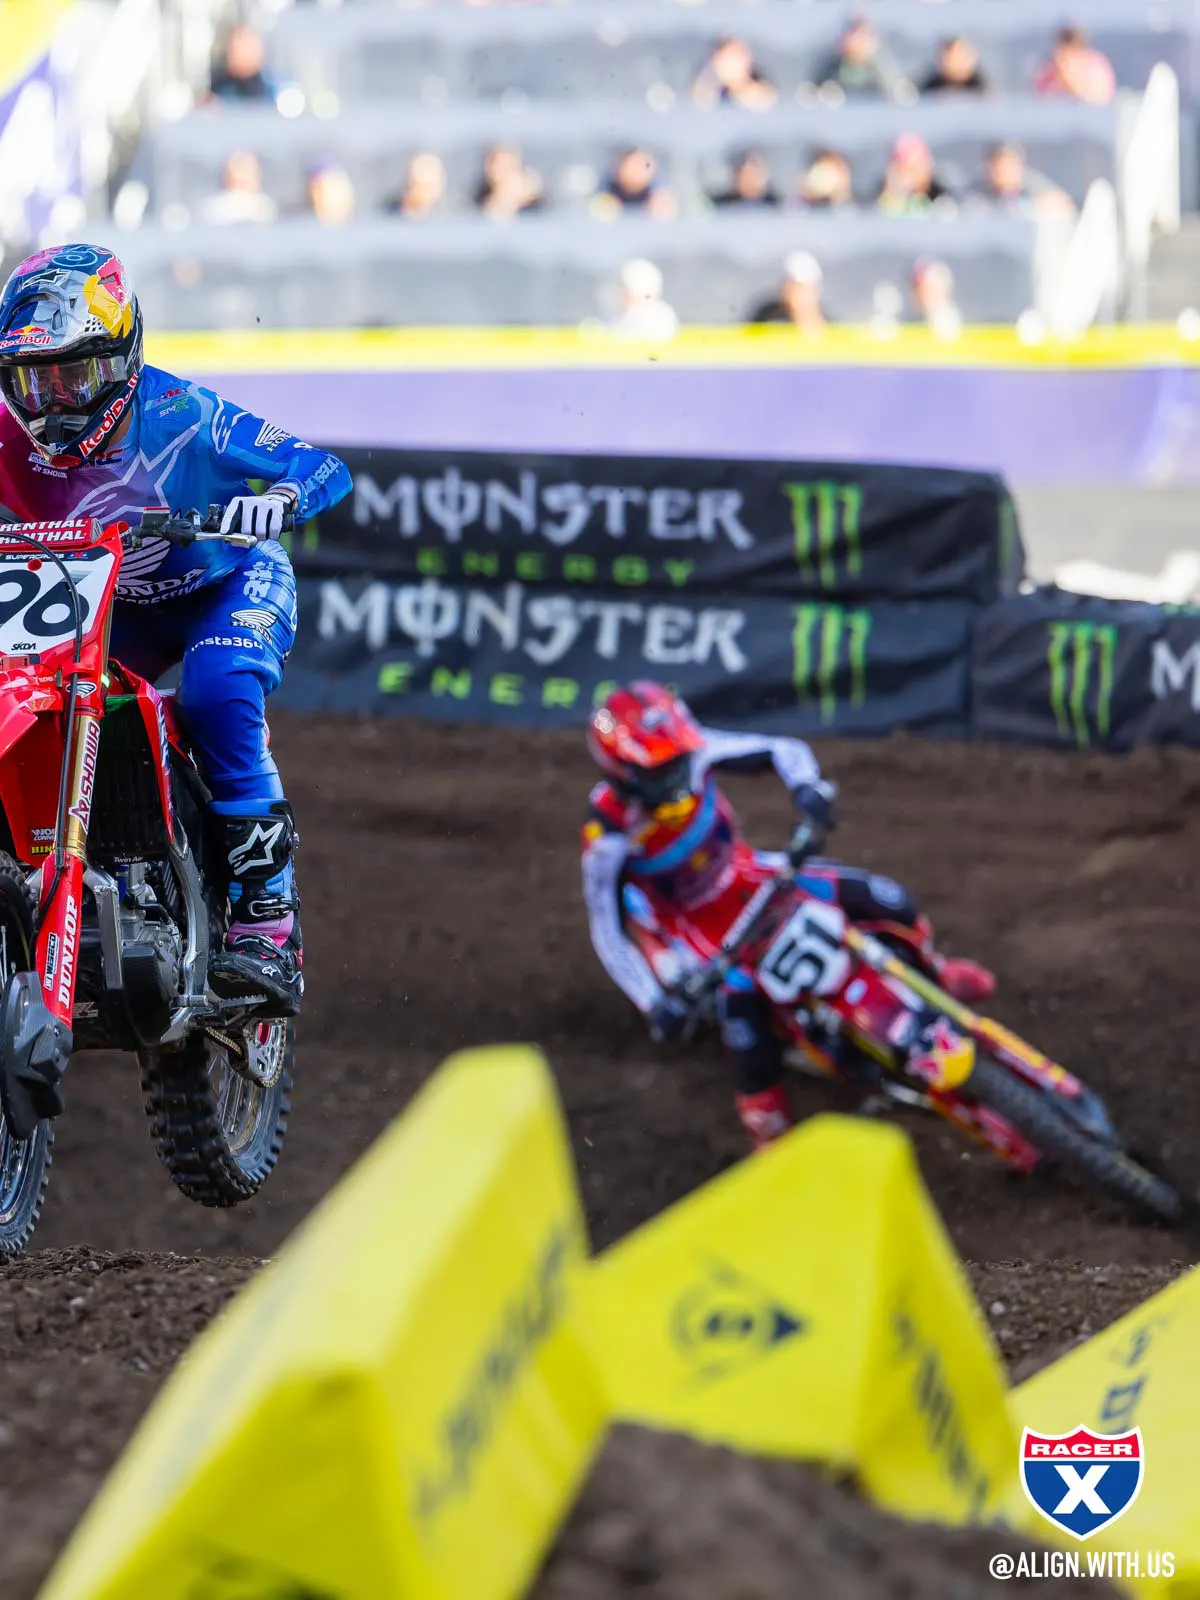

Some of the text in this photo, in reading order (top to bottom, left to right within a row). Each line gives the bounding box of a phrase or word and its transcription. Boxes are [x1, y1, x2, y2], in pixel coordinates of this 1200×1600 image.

[0, 519, 87, 532] RENTHAL
[351, 466, 756, 550] MONSTER
[116, 569, 207, 597] ONDA
[415, 547, 695, 585] ENERGY
[11, 641, 37, 651] SKDA
[318, 578, 750, 673] MONSTER
[378, 661, 626, 708] ENER
[81, 720, 100, 797] SHOWA
[58, 895, 78, 1009] DUNLOP
[771, 918, 840, 986] 51
